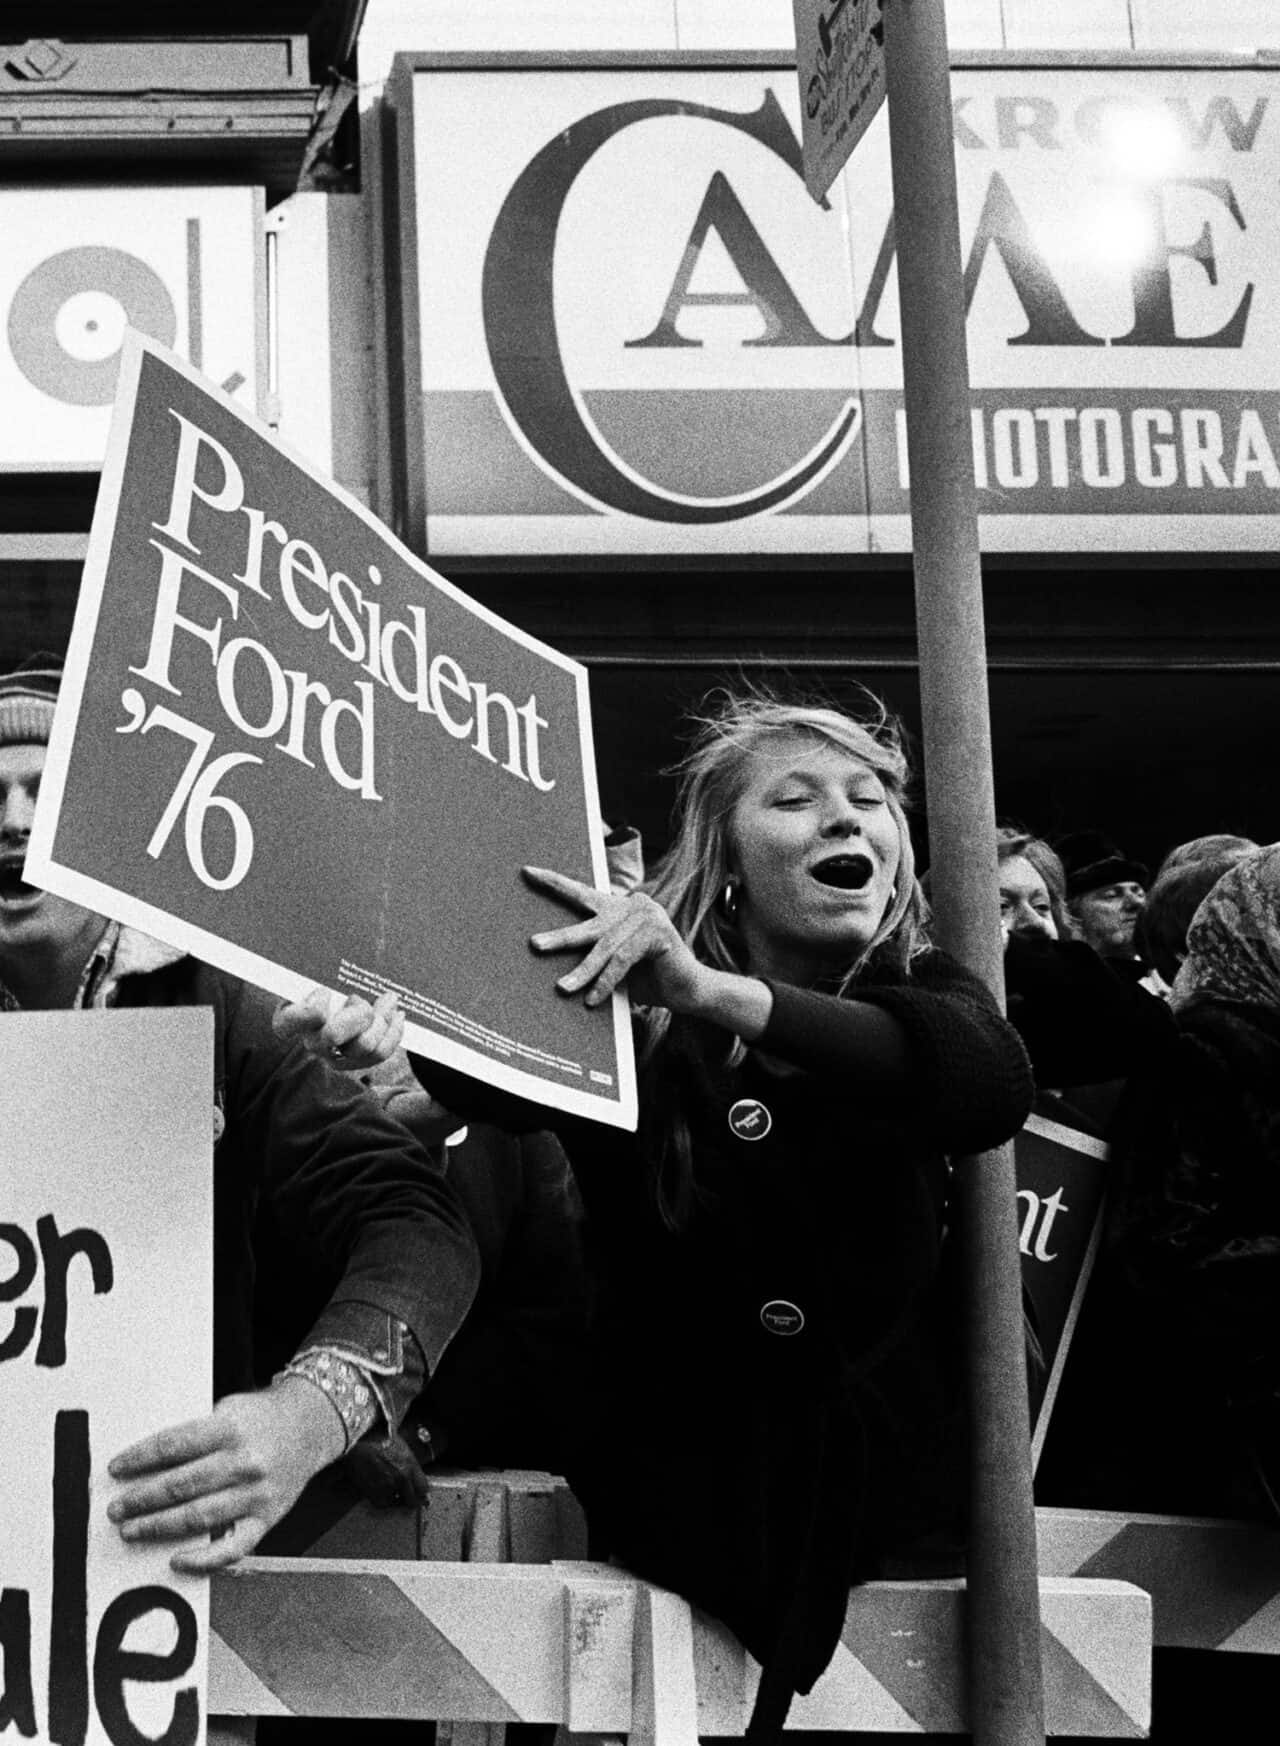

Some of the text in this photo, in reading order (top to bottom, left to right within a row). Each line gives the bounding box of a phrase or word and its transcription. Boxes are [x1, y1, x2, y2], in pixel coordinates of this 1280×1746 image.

[128, 538, 382, 800] Ford
[152, 408, 555, 791] President
[116, 688, 264, 890] '76
